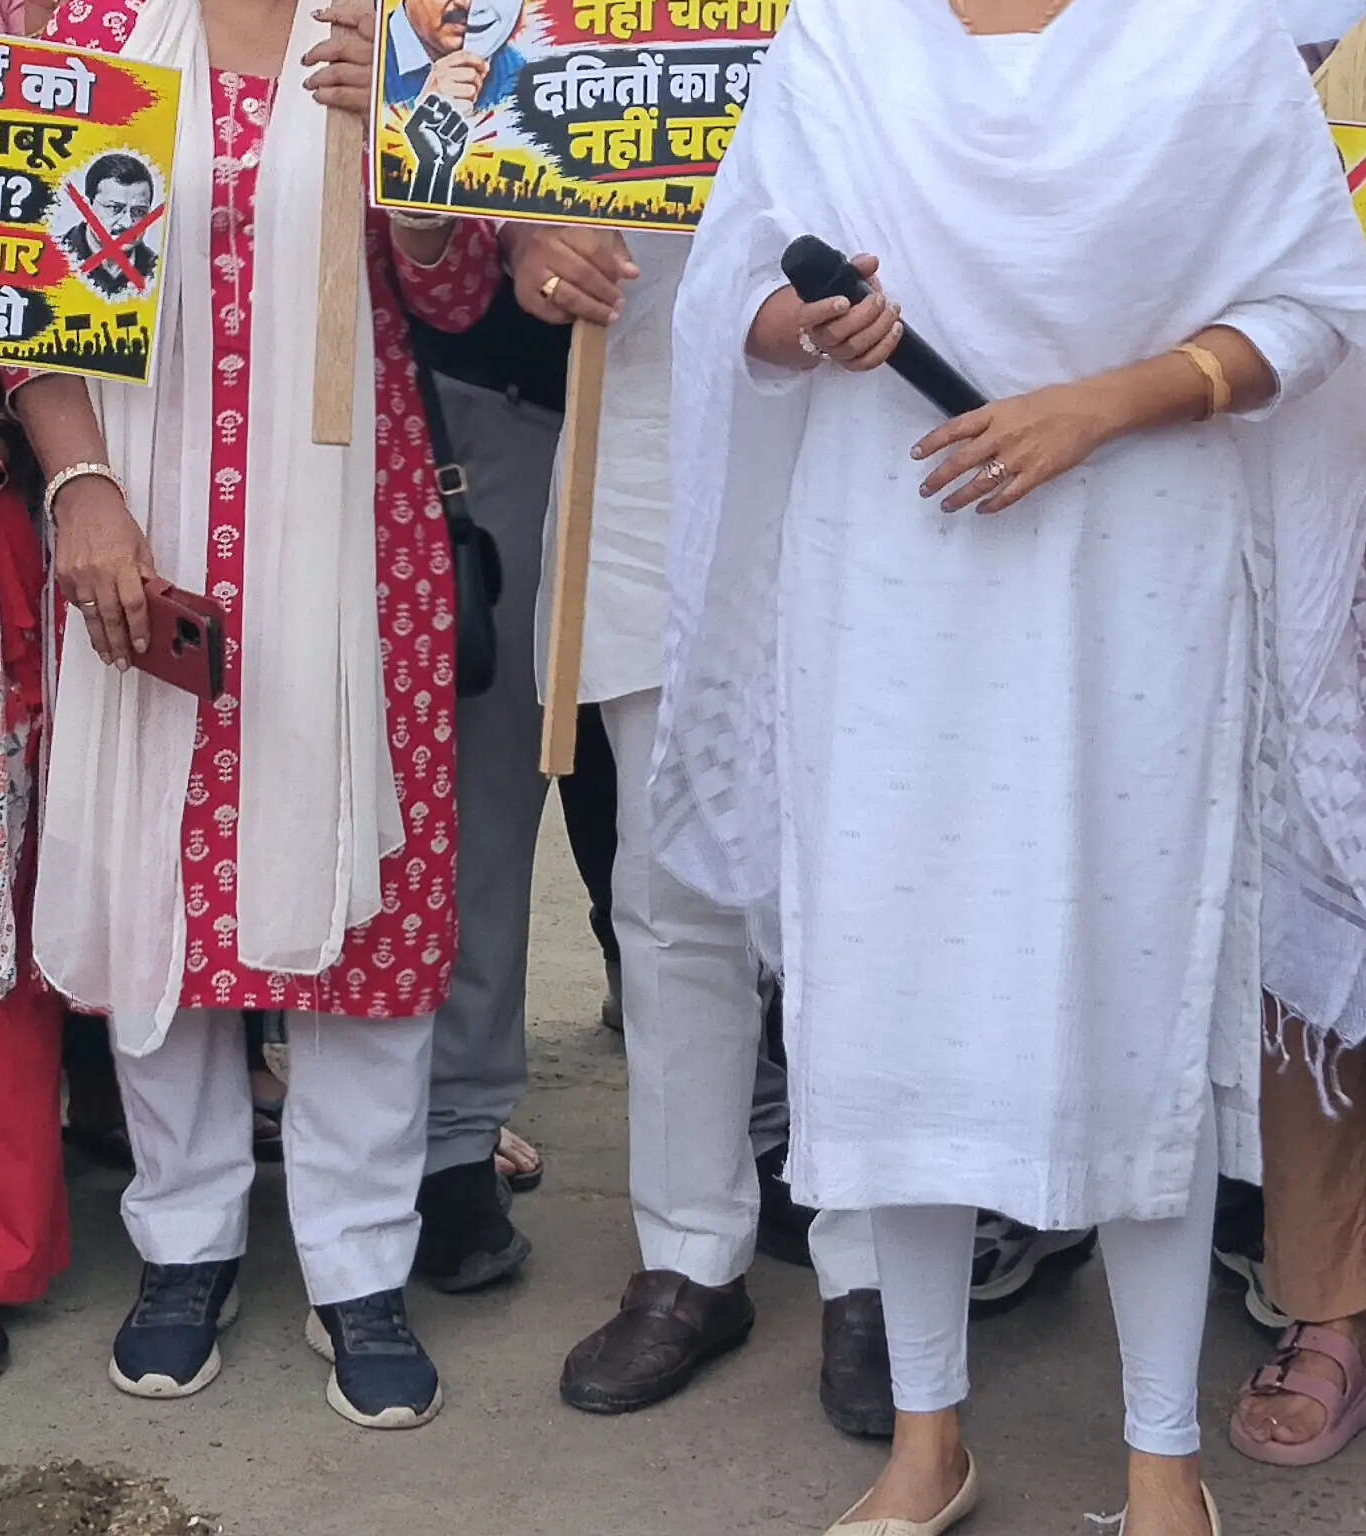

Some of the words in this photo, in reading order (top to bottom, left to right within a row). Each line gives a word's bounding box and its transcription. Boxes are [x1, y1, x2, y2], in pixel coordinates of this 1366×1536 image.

[19, 56, 96, 115] को
[533, 51, 664, 117] दलितों
[668, 63, 719, 104] का
[569, 110, 658, 171] नहीं
